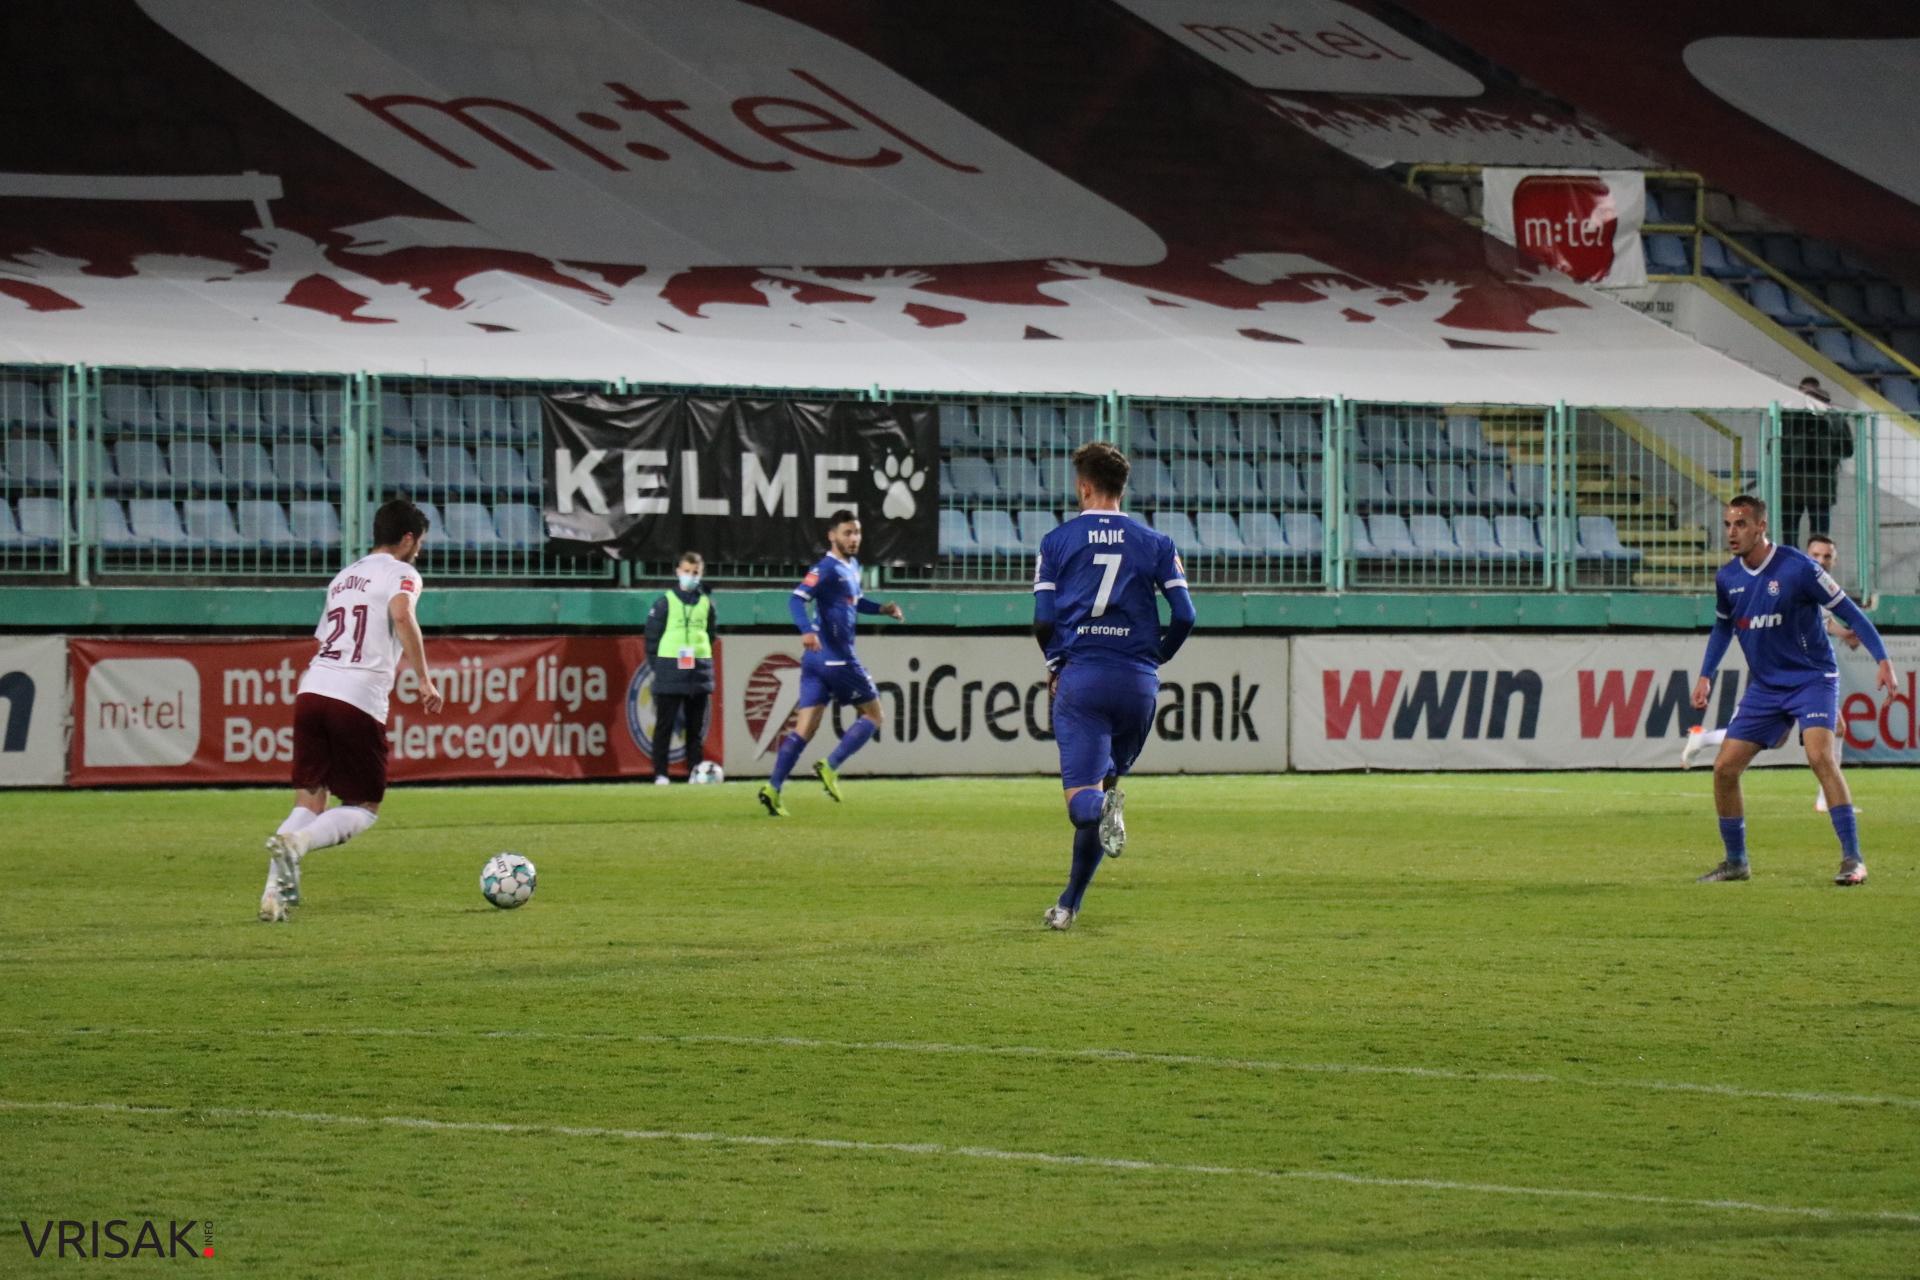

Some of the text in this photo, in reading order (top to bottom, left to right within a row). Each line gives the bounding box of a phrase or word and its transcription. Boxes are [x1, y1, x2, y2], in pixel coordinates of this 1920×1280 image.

[1181, 21, 1412, 61] m:tel
[345, 68, 983, 173] m:tel
[1524, 208, 1606, 248] m:tel
[554, 447, 860, 519] KELME
[1090, 553, 1122, 618] 7
[320, 604, 368, 663] 21
[100, 690, 185, 729] m:tel
[223, 657, 302, 706] m:t
[395, 656, 527, 714] emijer
[536, 655, 607, 712] liga
[1155, 672, 1260, 742] ank
[223, 717, 295, 763] Bos
